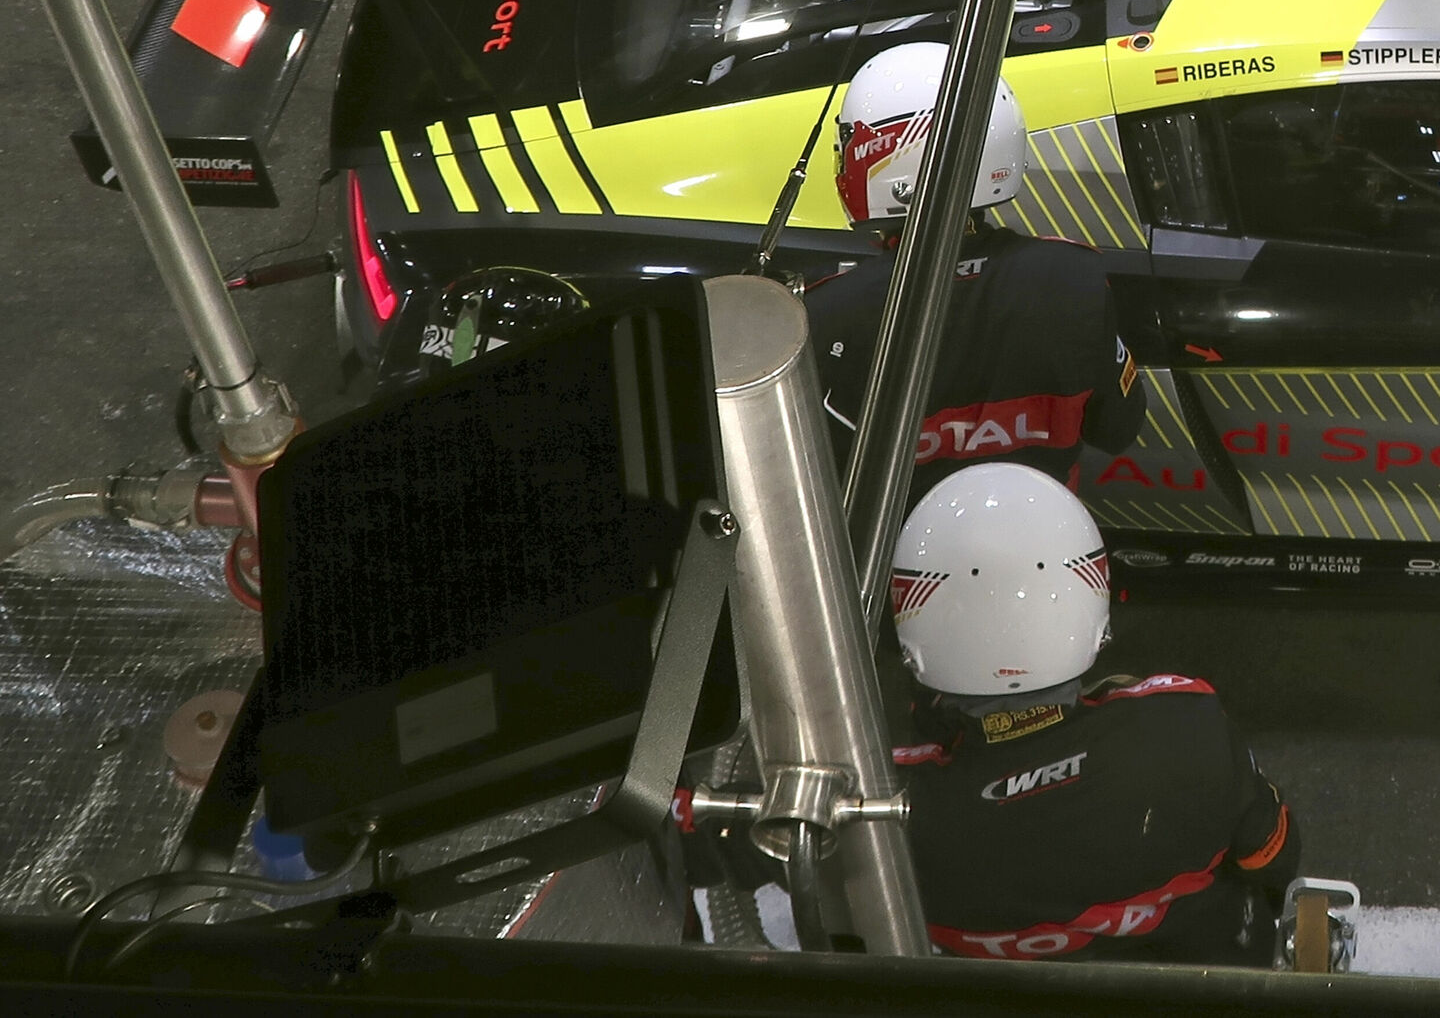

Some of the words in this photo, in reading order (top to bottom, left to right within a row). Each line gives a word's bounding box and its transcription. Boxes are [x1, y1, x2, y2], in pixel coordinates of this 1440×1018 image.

[1182, 56, 1276, 82] RIBERAS
[853, 132, 896, 162] WRT
[915, 412, 1049, 460] OTAL
[1184, 553, 1276, 568] Snap-on
[1288, 555, 1319, 564] THE
[1322, 555, 1362, 565] HEART
[1288, 563, 1305, 572] OF
[1310, 563, 1362, 574] RACING
[1005, 751, 1088, 797] WRT
